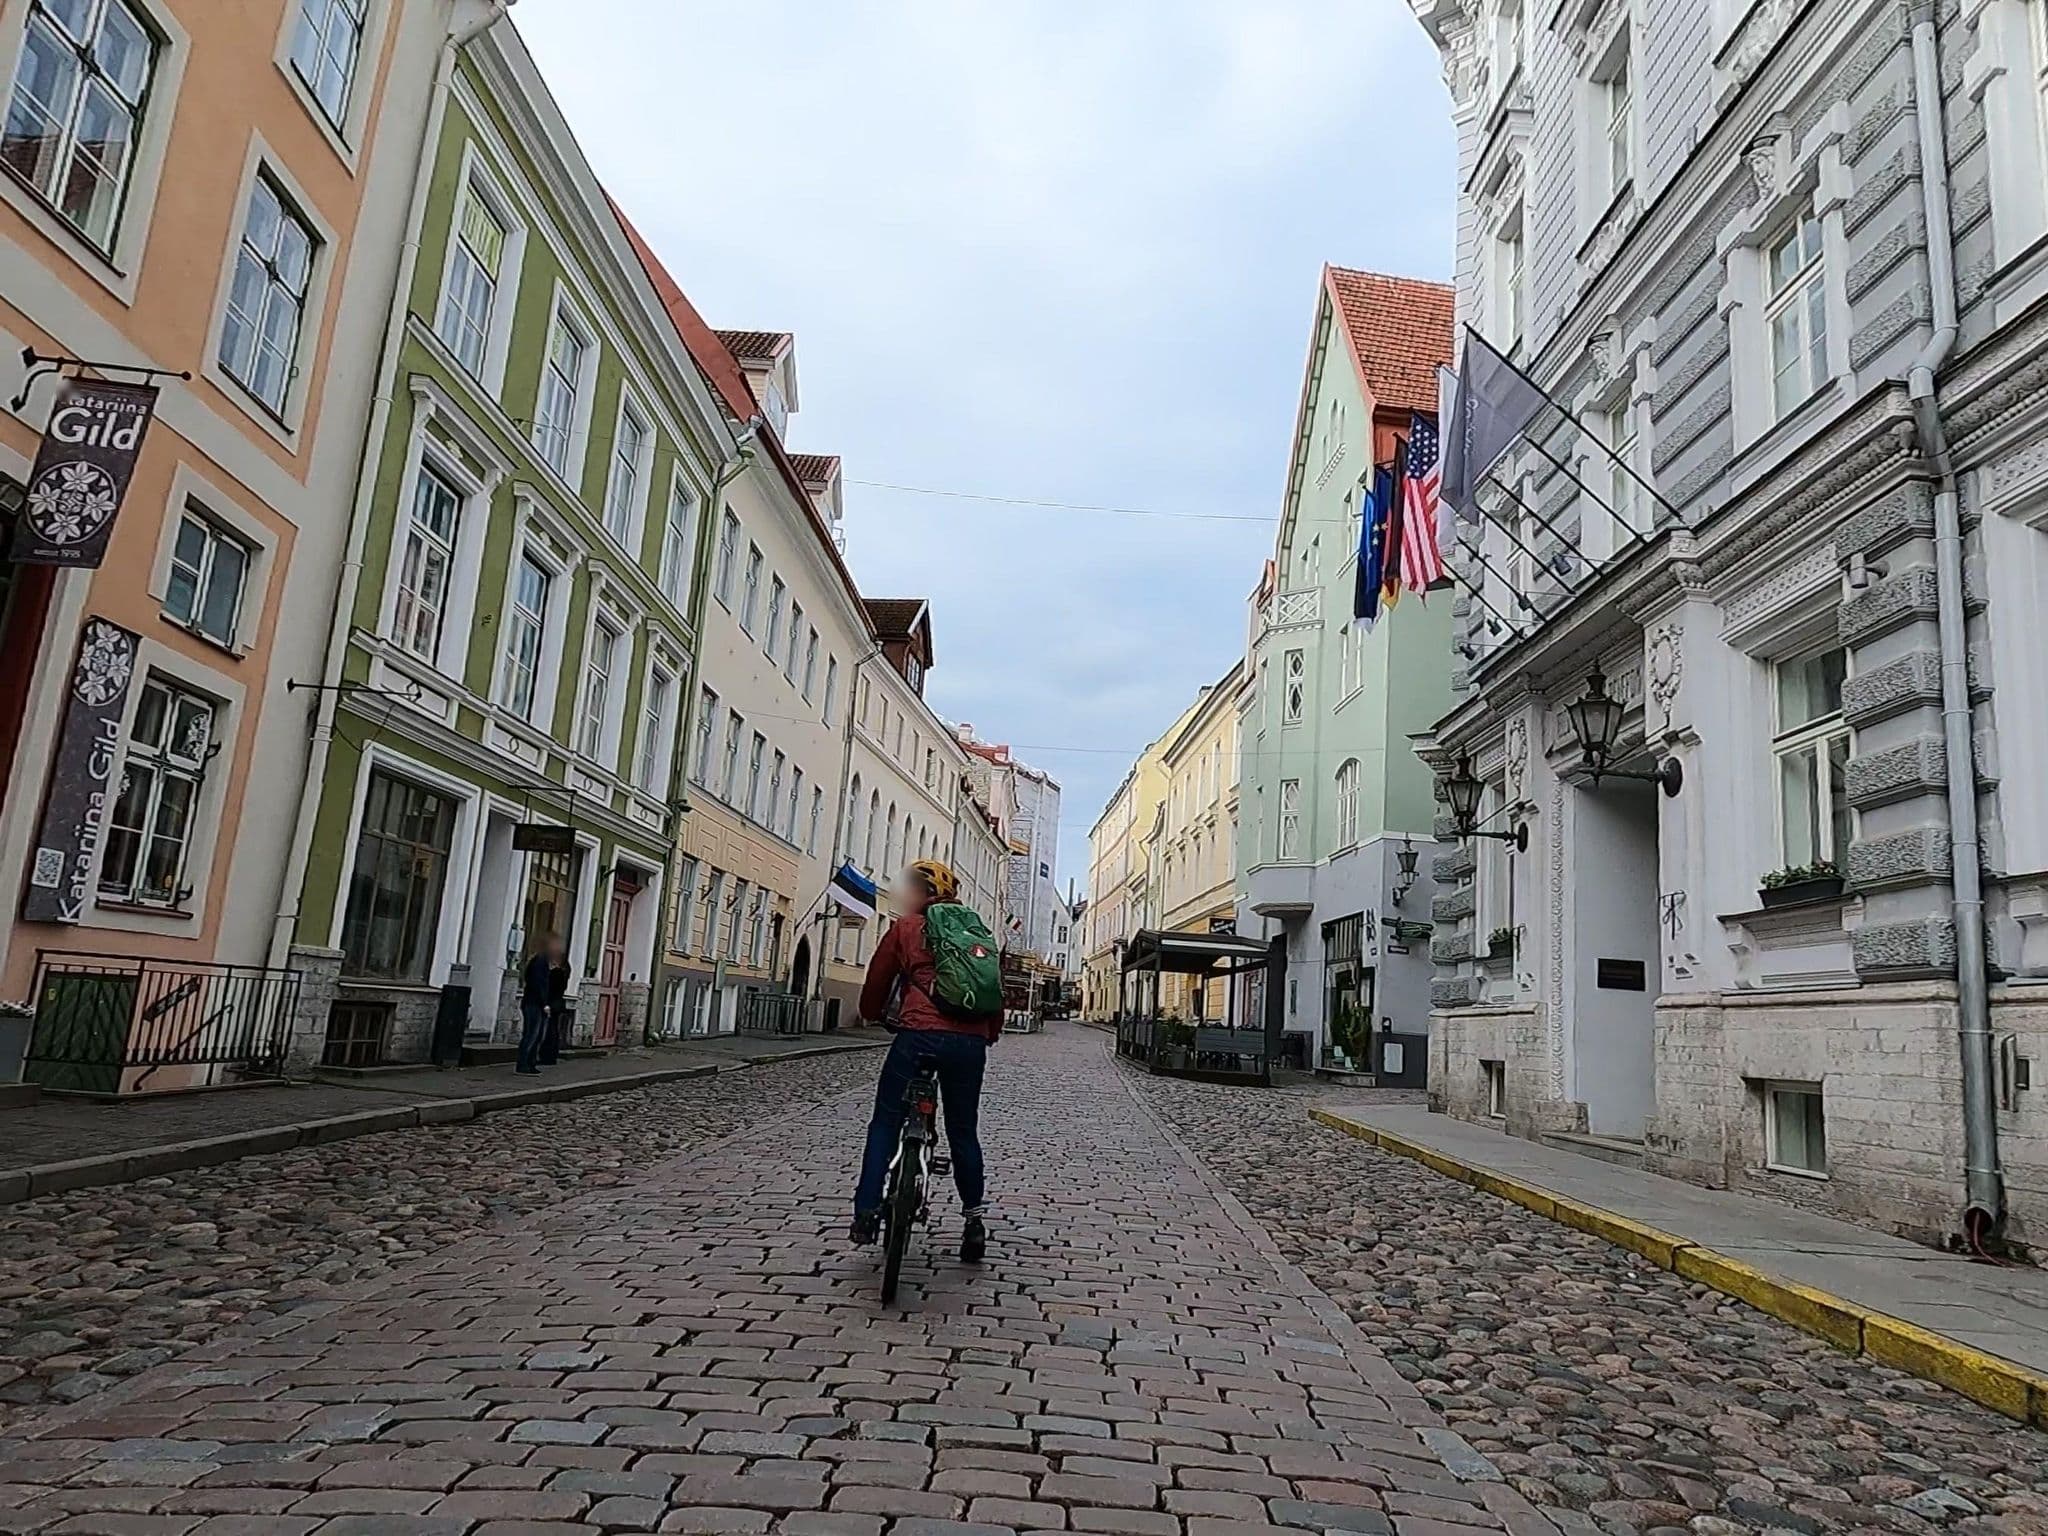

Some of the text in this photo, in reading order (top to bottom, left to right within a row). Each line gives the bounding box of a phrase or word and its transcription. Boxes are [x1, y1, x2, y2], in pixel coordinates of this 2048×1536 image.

[60, 396, 148, 415] atariina
[51, 406, 143, 450] Gild
[56, 717, 121, 924] Katariina Gild
